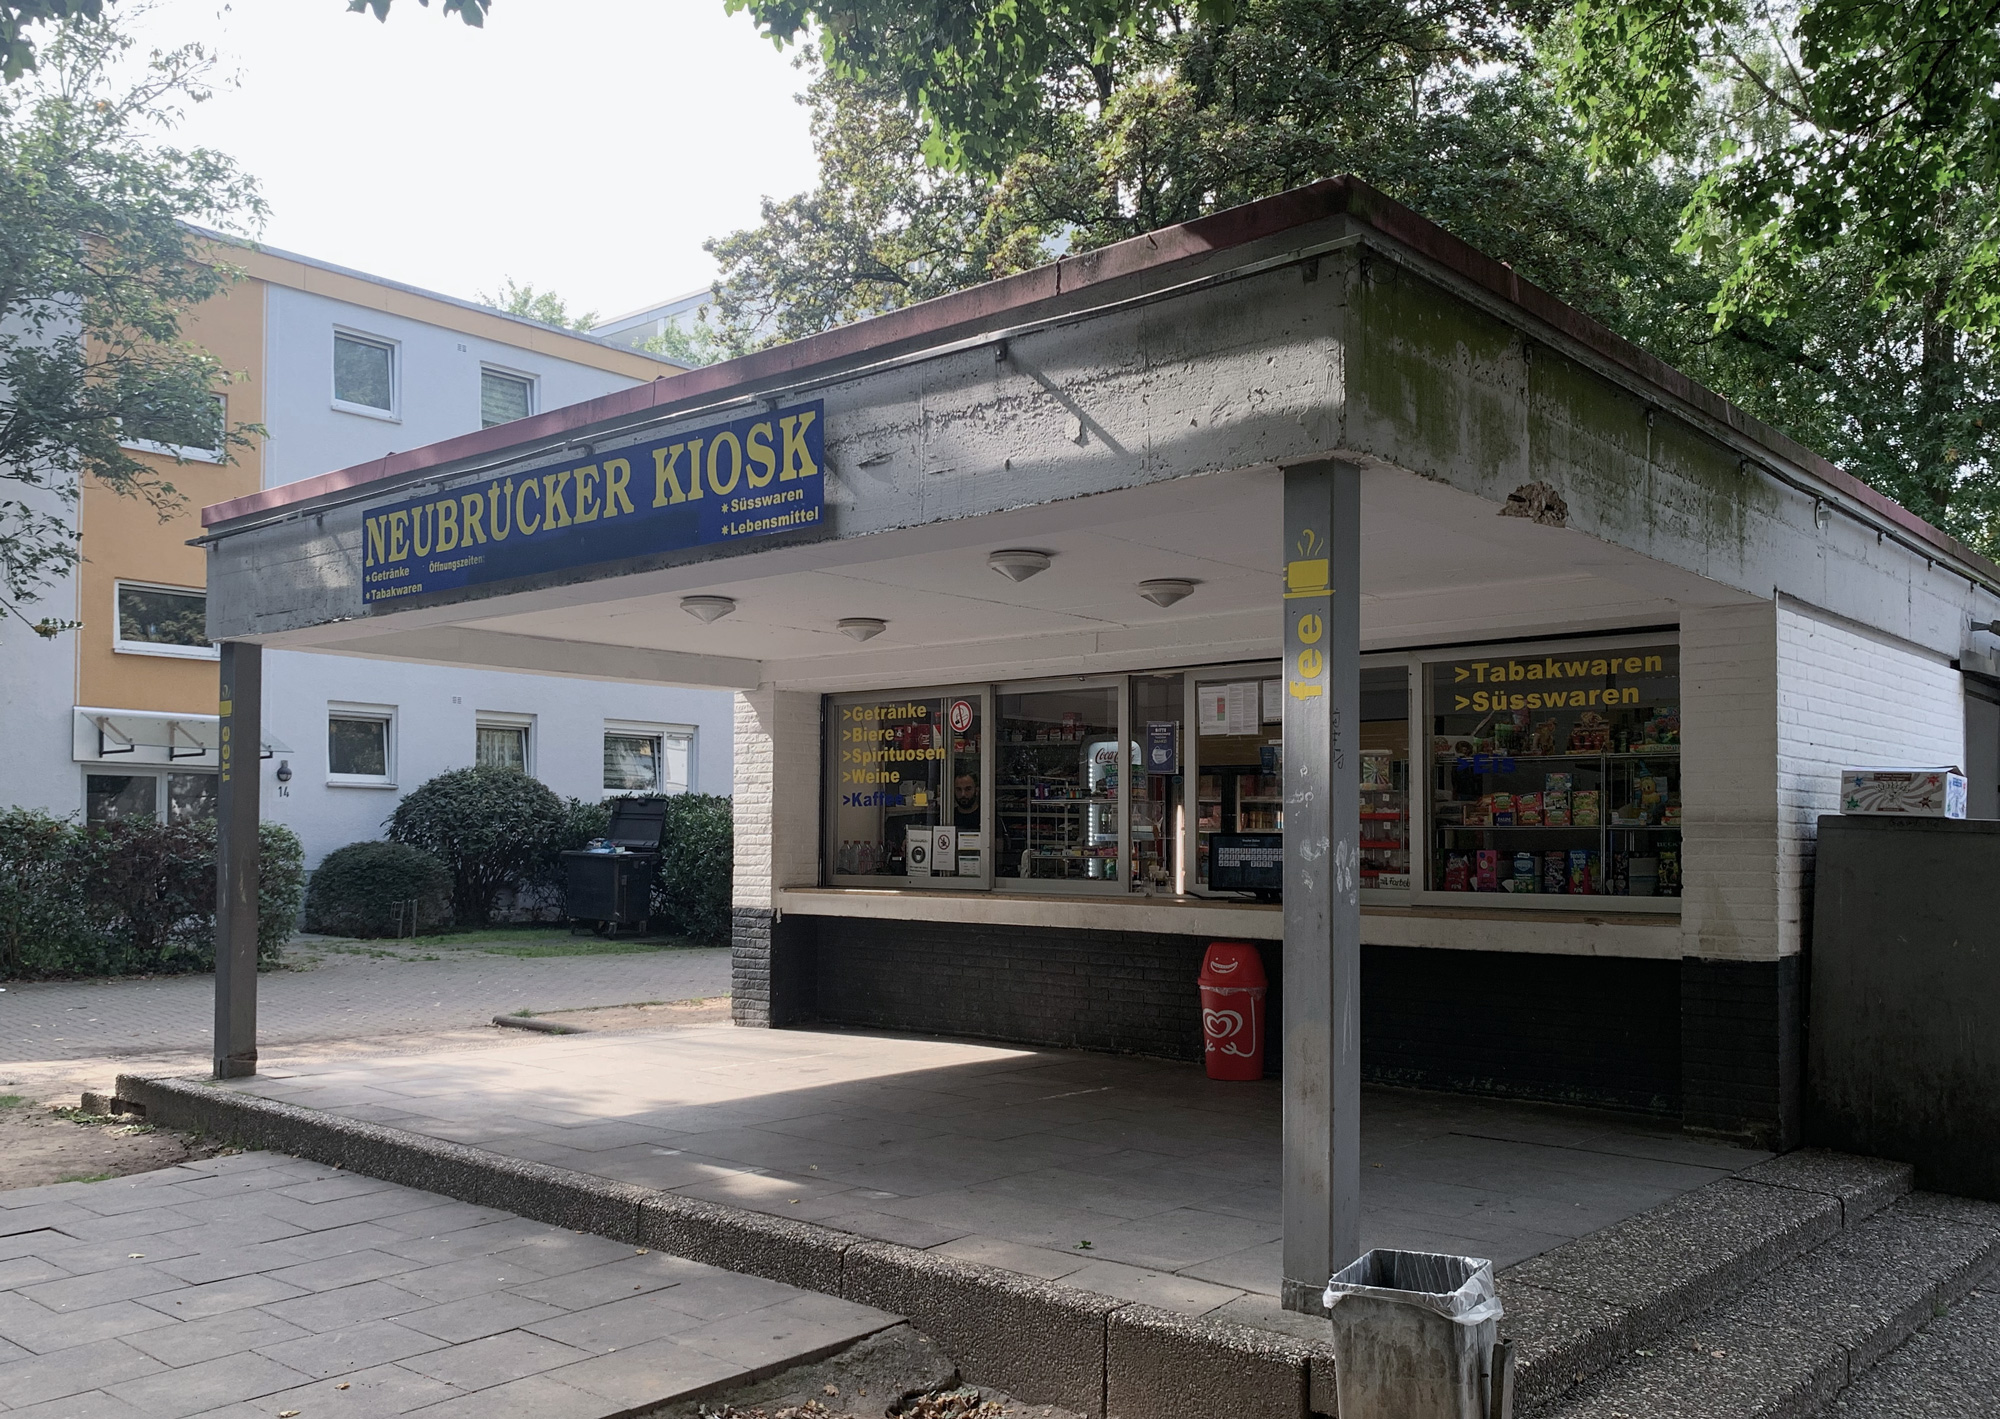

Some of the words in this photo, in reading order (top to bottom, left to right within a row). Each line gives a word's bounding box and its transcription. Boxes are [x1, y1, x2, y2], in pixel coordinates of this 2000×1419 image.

[365, 457, 635, 567] NEUBRÜCKER
[652, 410, 818, 508] KIOSK
[730, 488, 804, 513] Süsswaren
[730, 505, 819, 536] Lebensmittel
[371, 566, 410, 583] Getränke
[371, 582, 423, 601] Tabakwaren
[278, 786, 290, 798] 14
